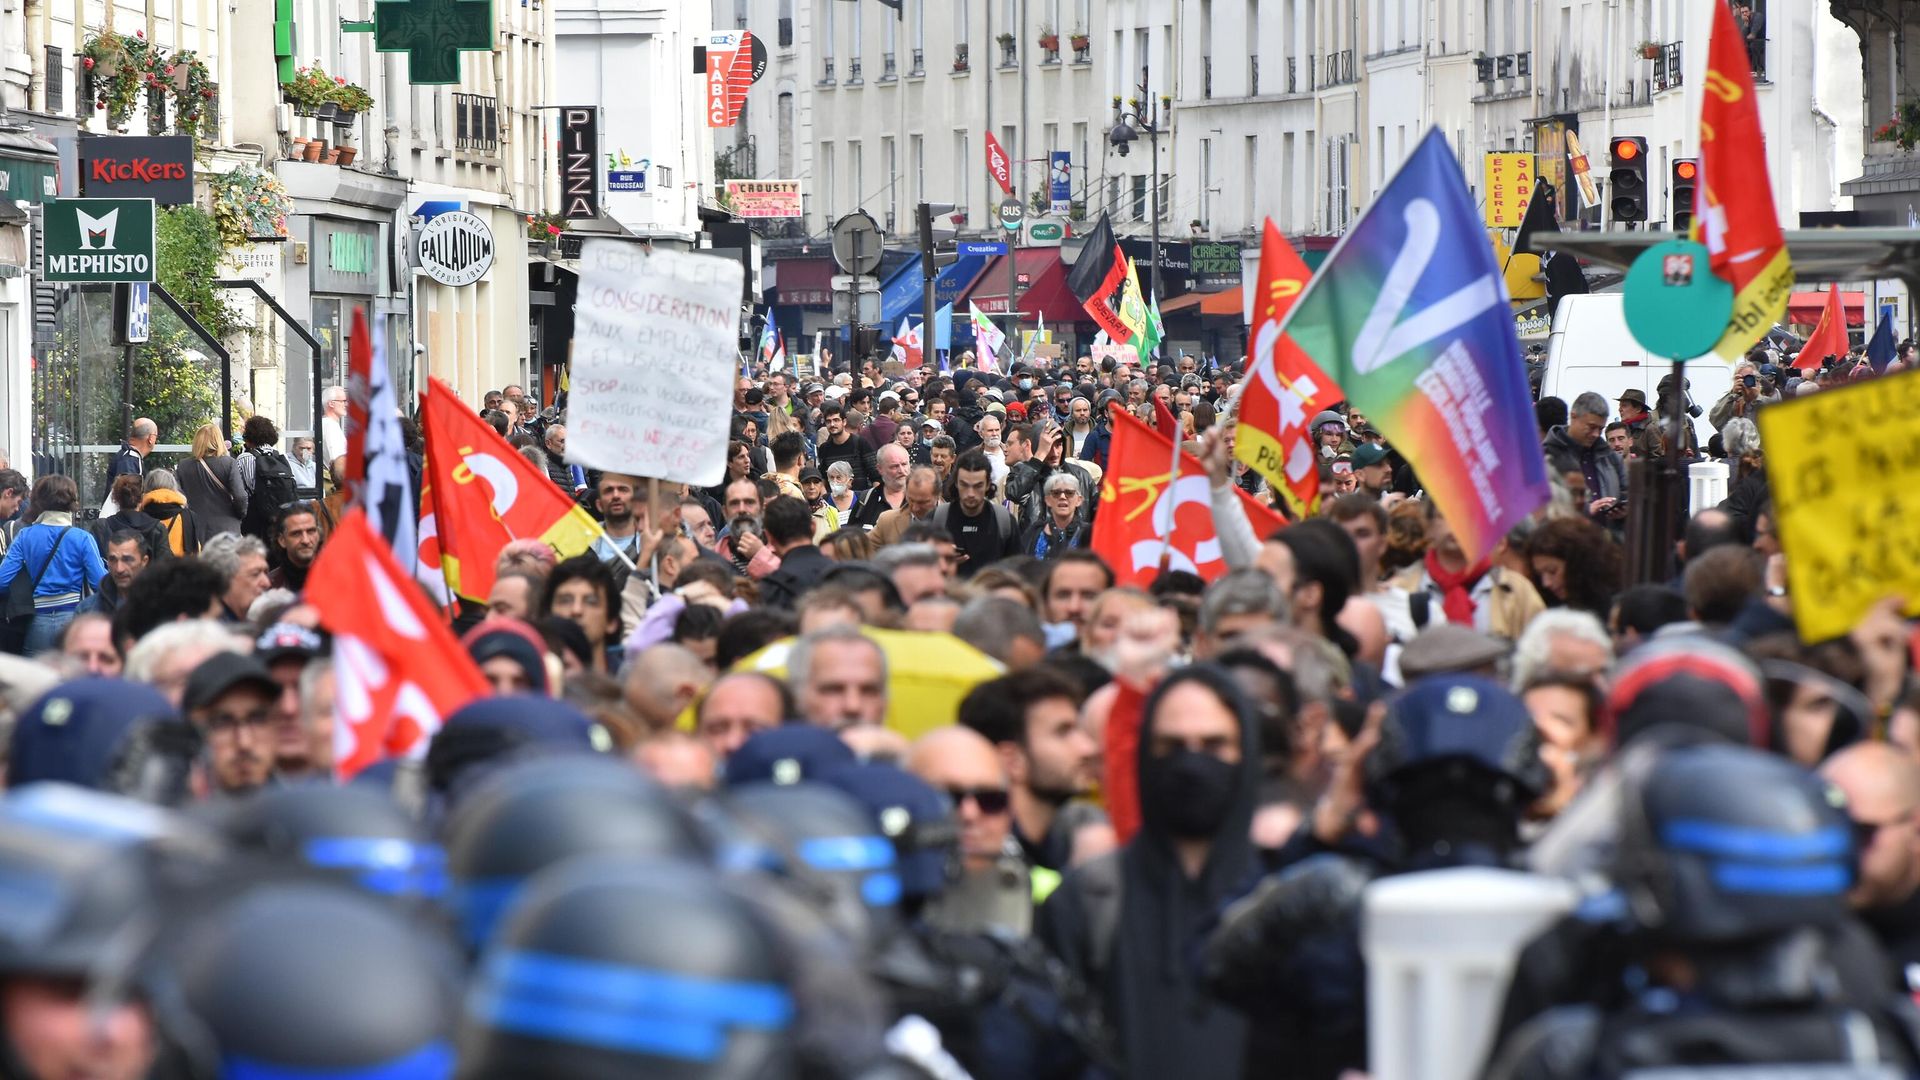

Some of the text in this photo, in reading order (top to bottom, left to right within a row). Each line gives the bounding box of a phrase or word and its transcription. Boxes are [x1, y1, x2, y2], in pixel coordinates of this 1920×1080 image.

[752, 60, 766, 79] PAIN
[710, 55, 724, 125] TABAC
[566, 109, 593, 217] PIZZA
[987, 143, 1007, 182] TABAC
[609, 181, 645, 190] TROUSSEAU
[619, 174, 634, 182] RUE
[1002, 205, 1021, 216] BUS
[427, 213, 485, 234] L'ORIGINALE
[421, 226, 491, 272] PALLADIUM
[48, 254, 149, 275] MEPHISTO
[430, 264, 485, 283] DEPUIS 1947
[591, 286, 731, 330] CONSIDERATION
[1092, 297, 1128, 338] GUEVARA
[588, 320, 624, 344] AUX
[591, 347, 611, 367] ET
[577, 378, 619, 395] STOP
